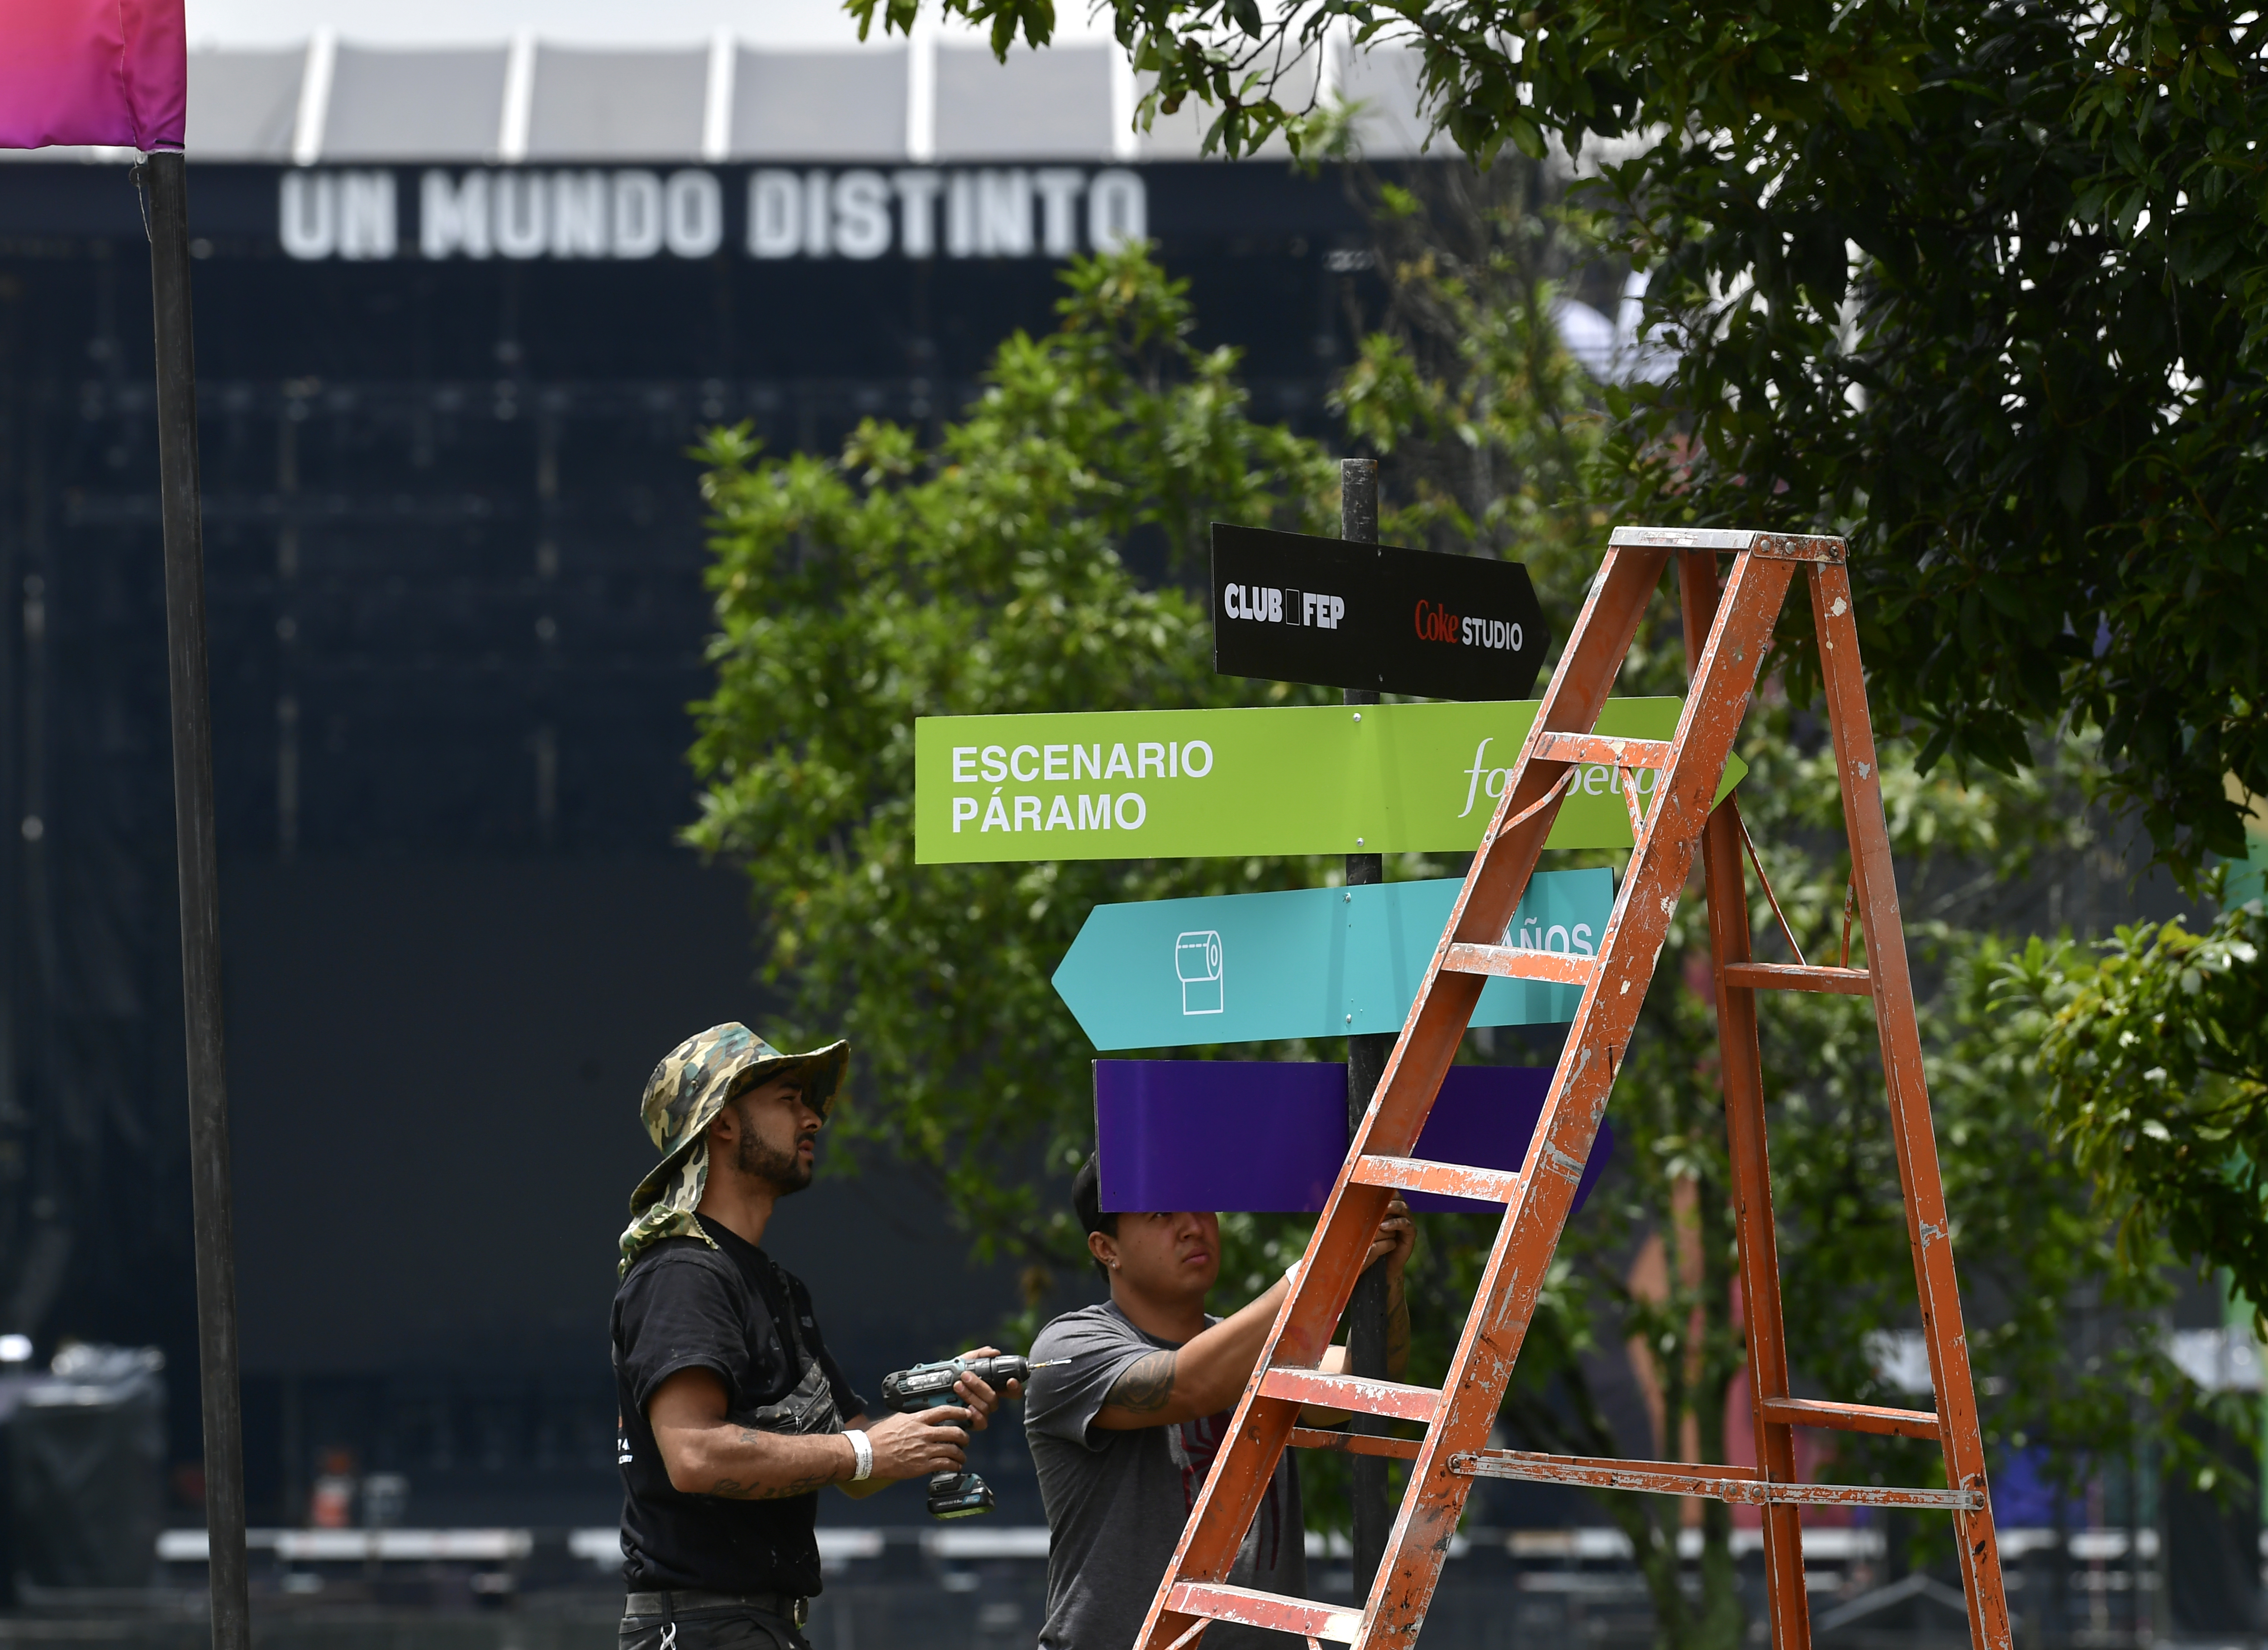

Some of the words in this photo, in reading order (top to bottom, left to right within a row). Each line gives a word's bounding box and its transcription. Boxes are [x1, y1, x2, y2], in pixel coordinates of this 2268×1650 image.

[279, 167, 399, 261] UN
[419, 167, 723, 260] MUNDO
[746, 167, 1148, 261] DISTINTO
[1224, 582, 1283, 622] CLUB
[1303, 592, 1345, 629] FEP
[1414, 599, 1460, 644] Coke
[1462, 616, 1523, 652] STUDIO
[952, 740, 1214, 782] ESCENARIO
[952, 787, 1147, 833] PÁRAMO
